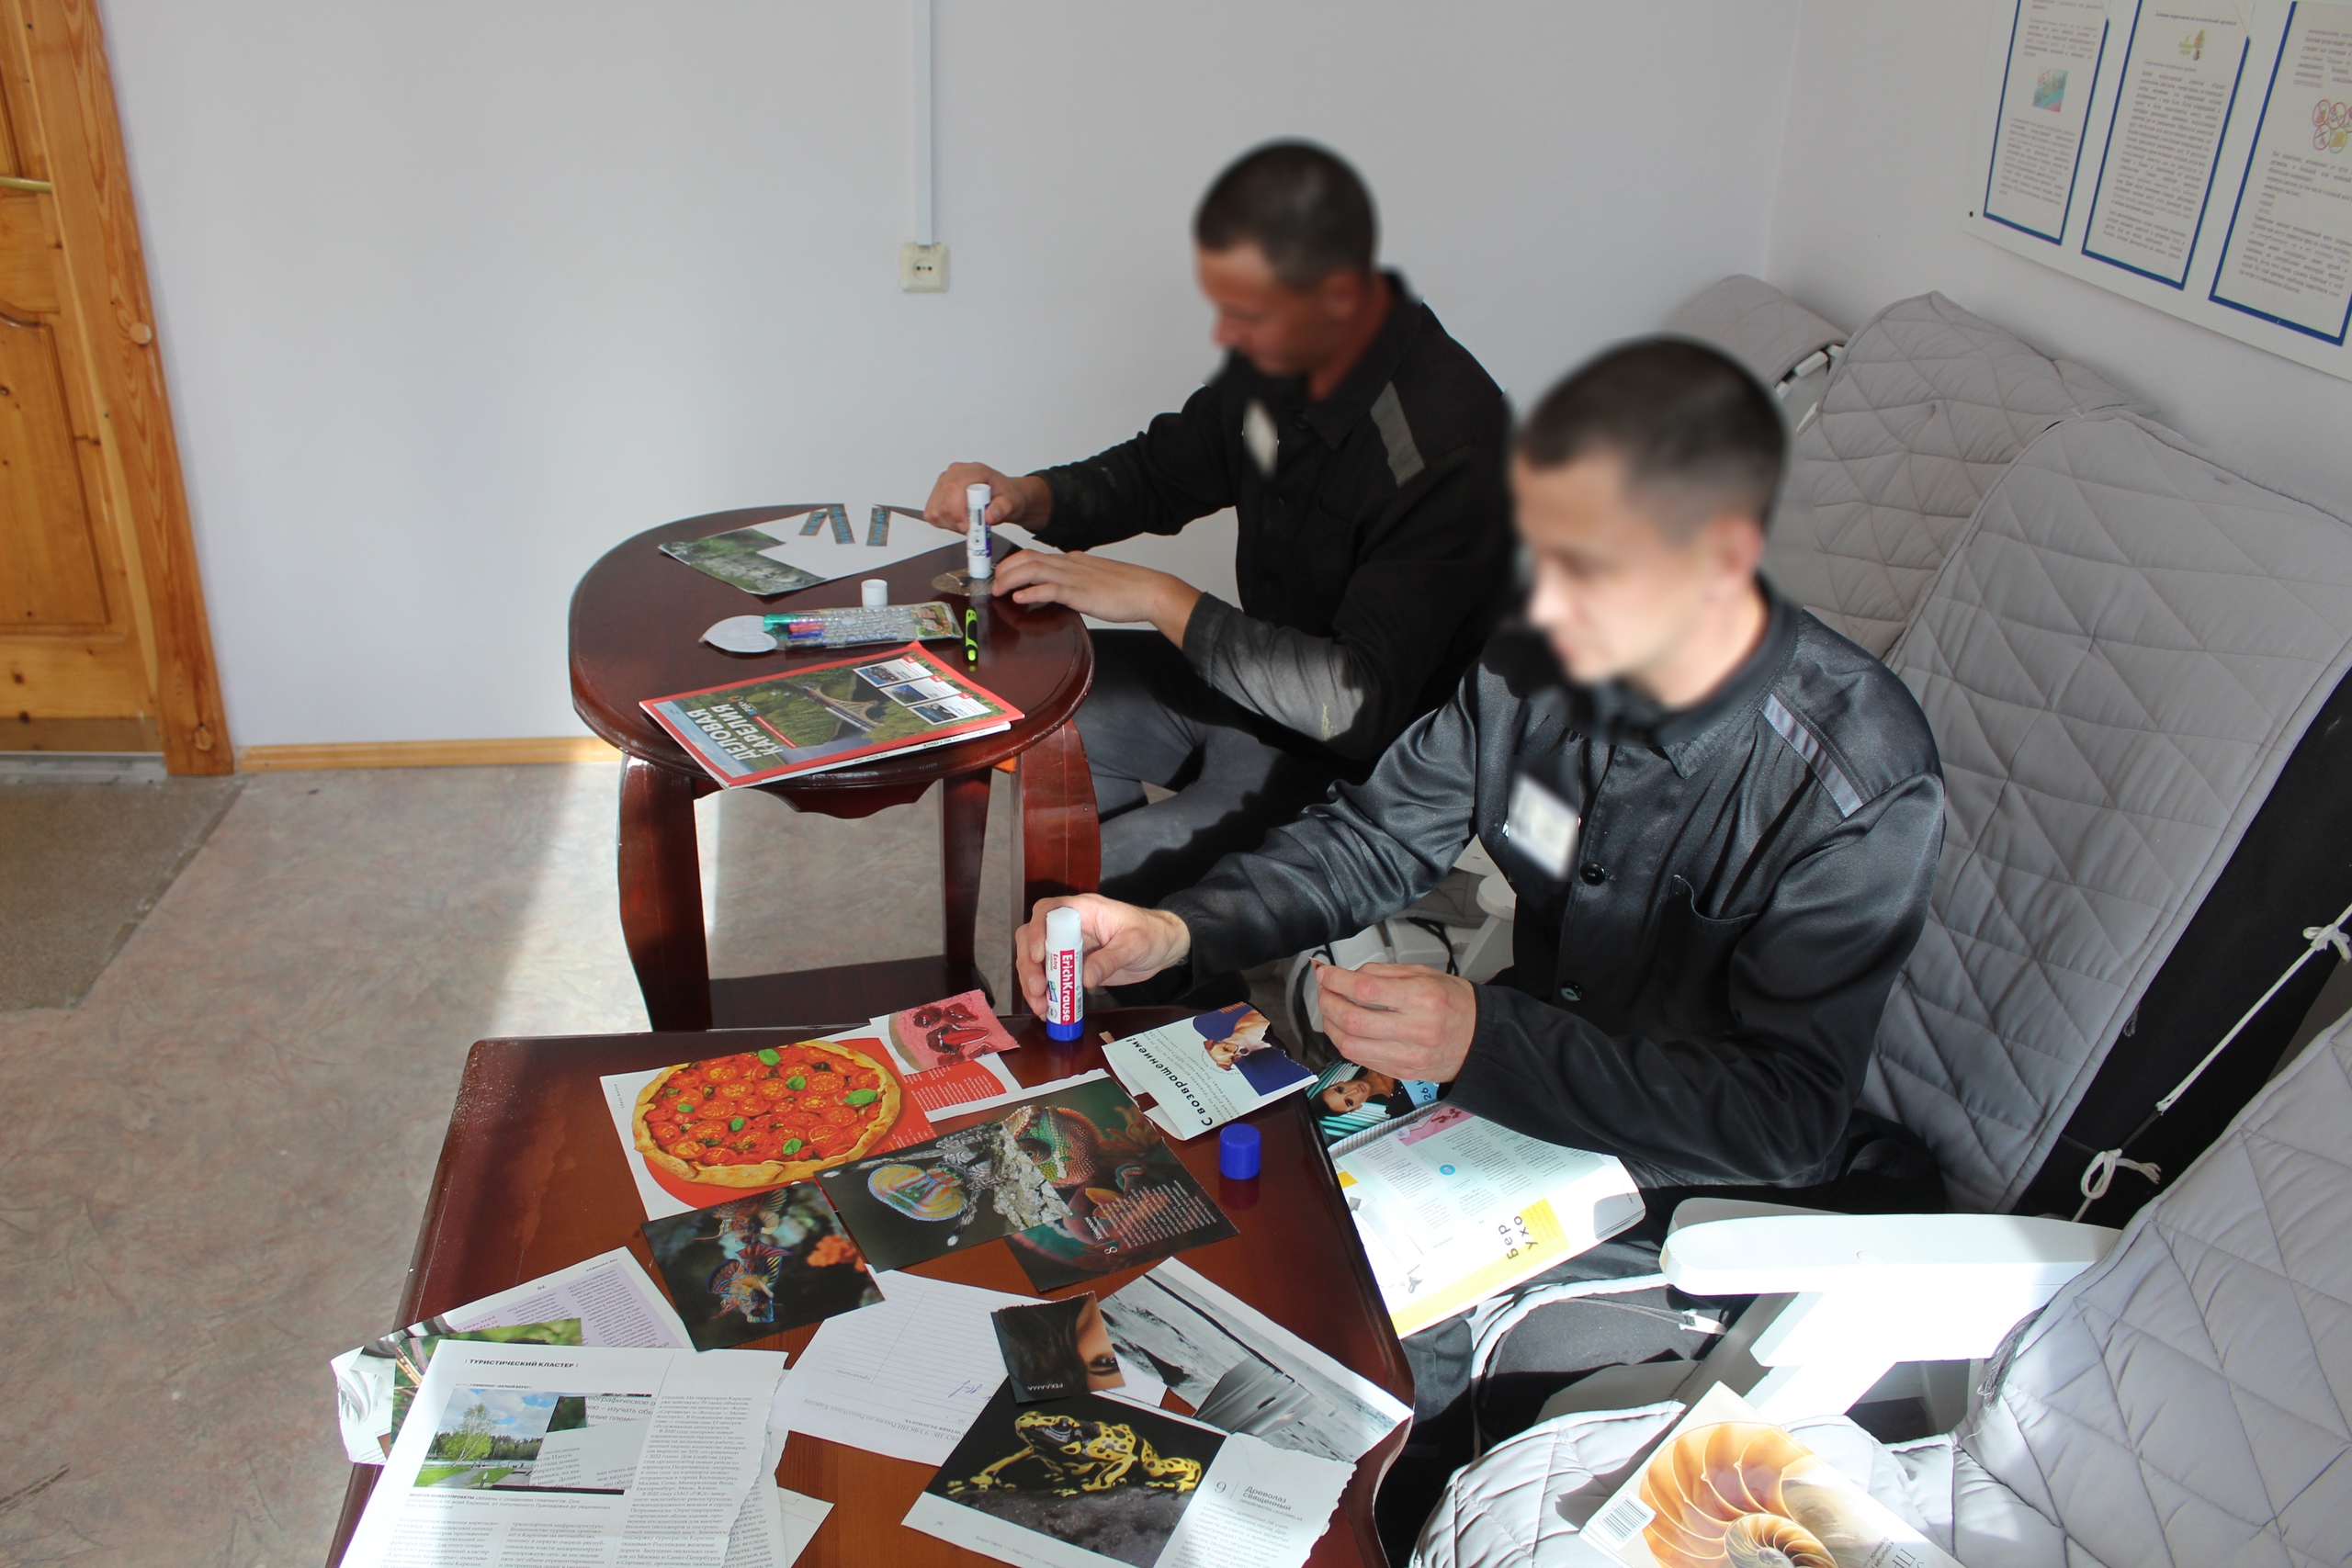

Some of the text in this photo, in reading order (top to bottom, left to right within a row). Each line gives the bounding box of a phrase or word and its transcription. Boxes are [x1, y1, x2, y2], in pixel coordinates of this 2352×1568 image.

[685, 708, 761, 761] ДЕЛОВАЯ
[710, 703, 784, 756] КАРЕЛИЯ
[1062, 953, 1073, 1021] ErichKrause
[1125, 1037, 1213, 1126] С возвращением!
[1496, 1224, 1519, 1259] Бер
[469, 1359, 537, 1367] ТУРИСТИЧЕСКИЙ
[1026, 1382, 1064, 1391] РЕКЛАМА
[875, 1417, 897, 1427] России
[1215, 1481, 1227, 1494] 9
[1246, 1486, 1287, 1504] Древолаз
[1242, 1492, 1292, 1511] священный
